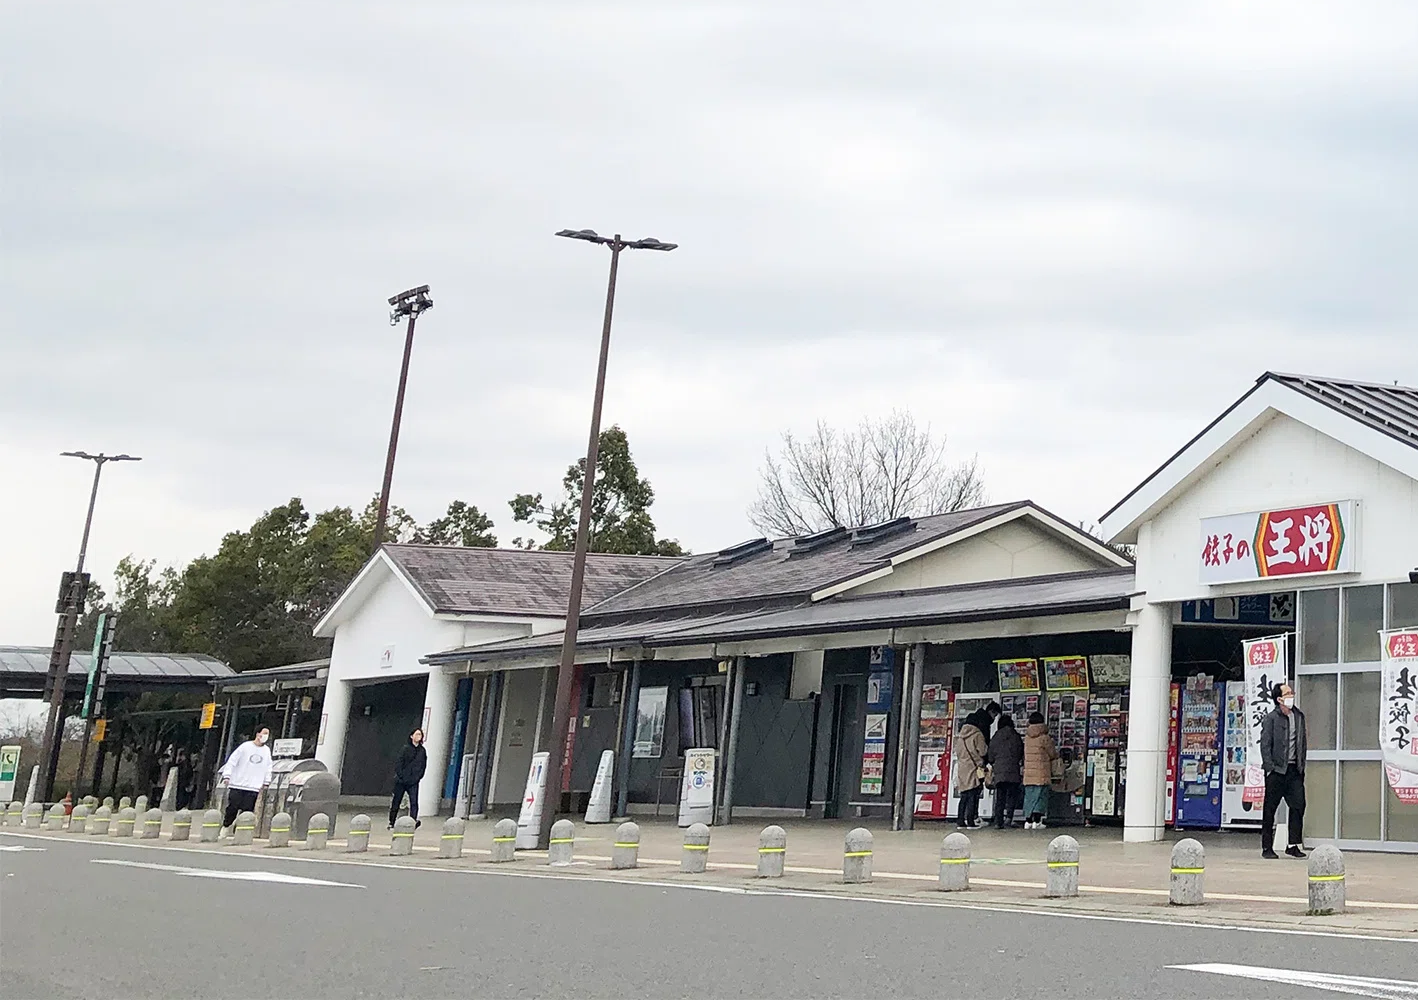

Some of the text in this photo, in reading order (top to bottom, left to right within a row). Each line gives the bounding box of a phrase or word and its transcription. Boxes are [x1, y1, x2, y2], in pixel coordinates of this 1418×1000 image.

[1201, 511, 1331, 567] 餃子の王将
